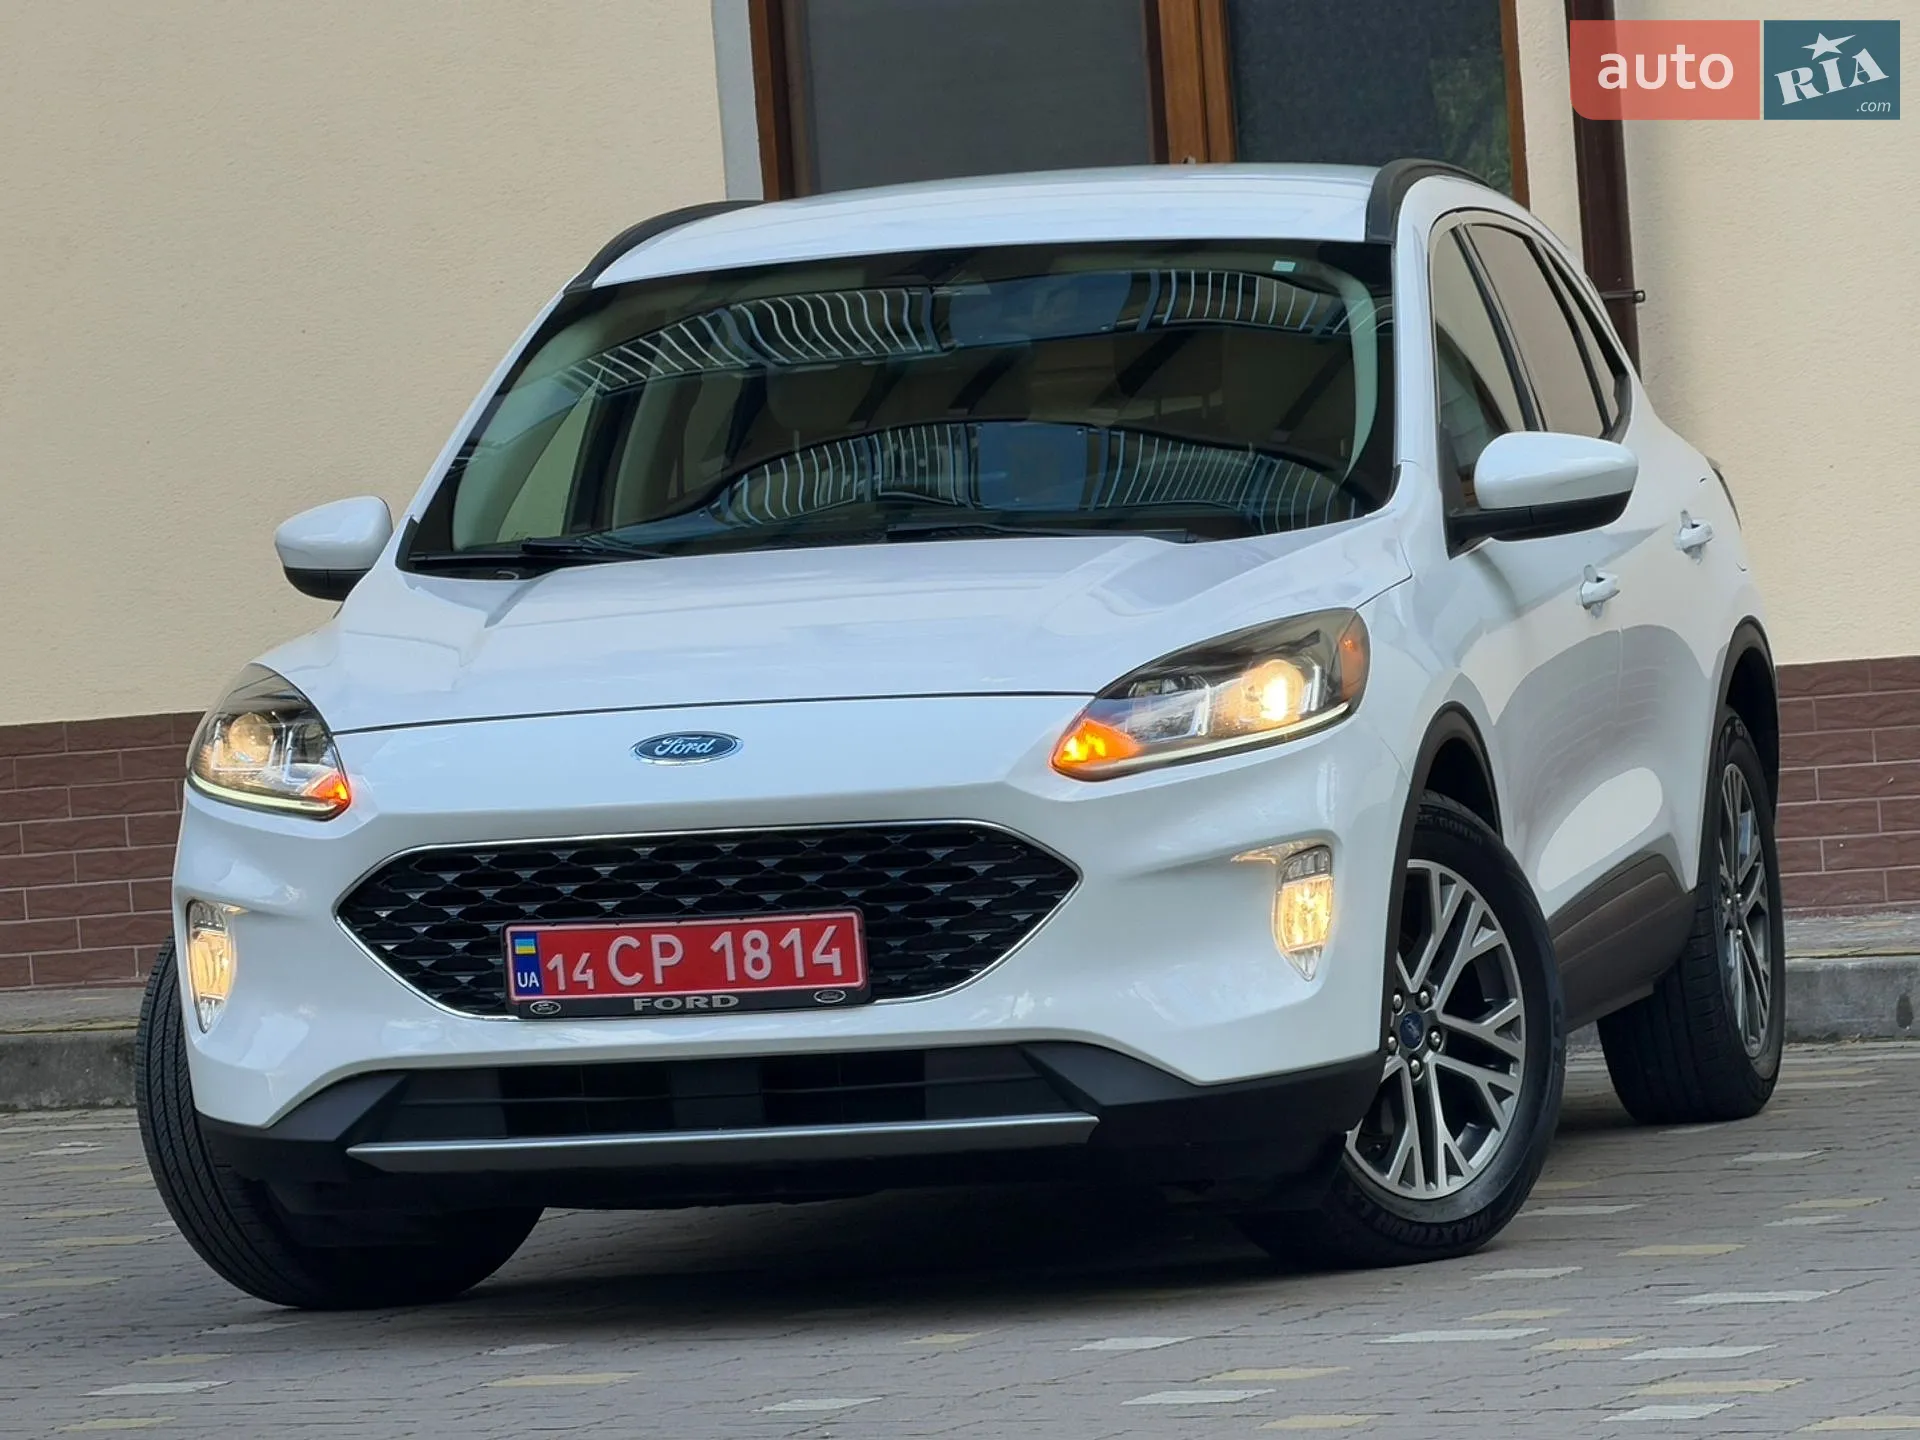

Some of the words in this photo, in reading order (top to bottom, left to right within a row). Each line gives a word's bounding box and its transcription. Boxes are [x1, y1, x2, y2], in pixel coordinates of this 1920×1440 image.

[654, 736, 716, 756] Ford
[546, 952, 595, 991] 14
[607, 933, 684, 986] CP
[710, 925, 843, 983] 1814
[517, 971, 540, 988] UA
[633, 994, 739, 1012] FORD
